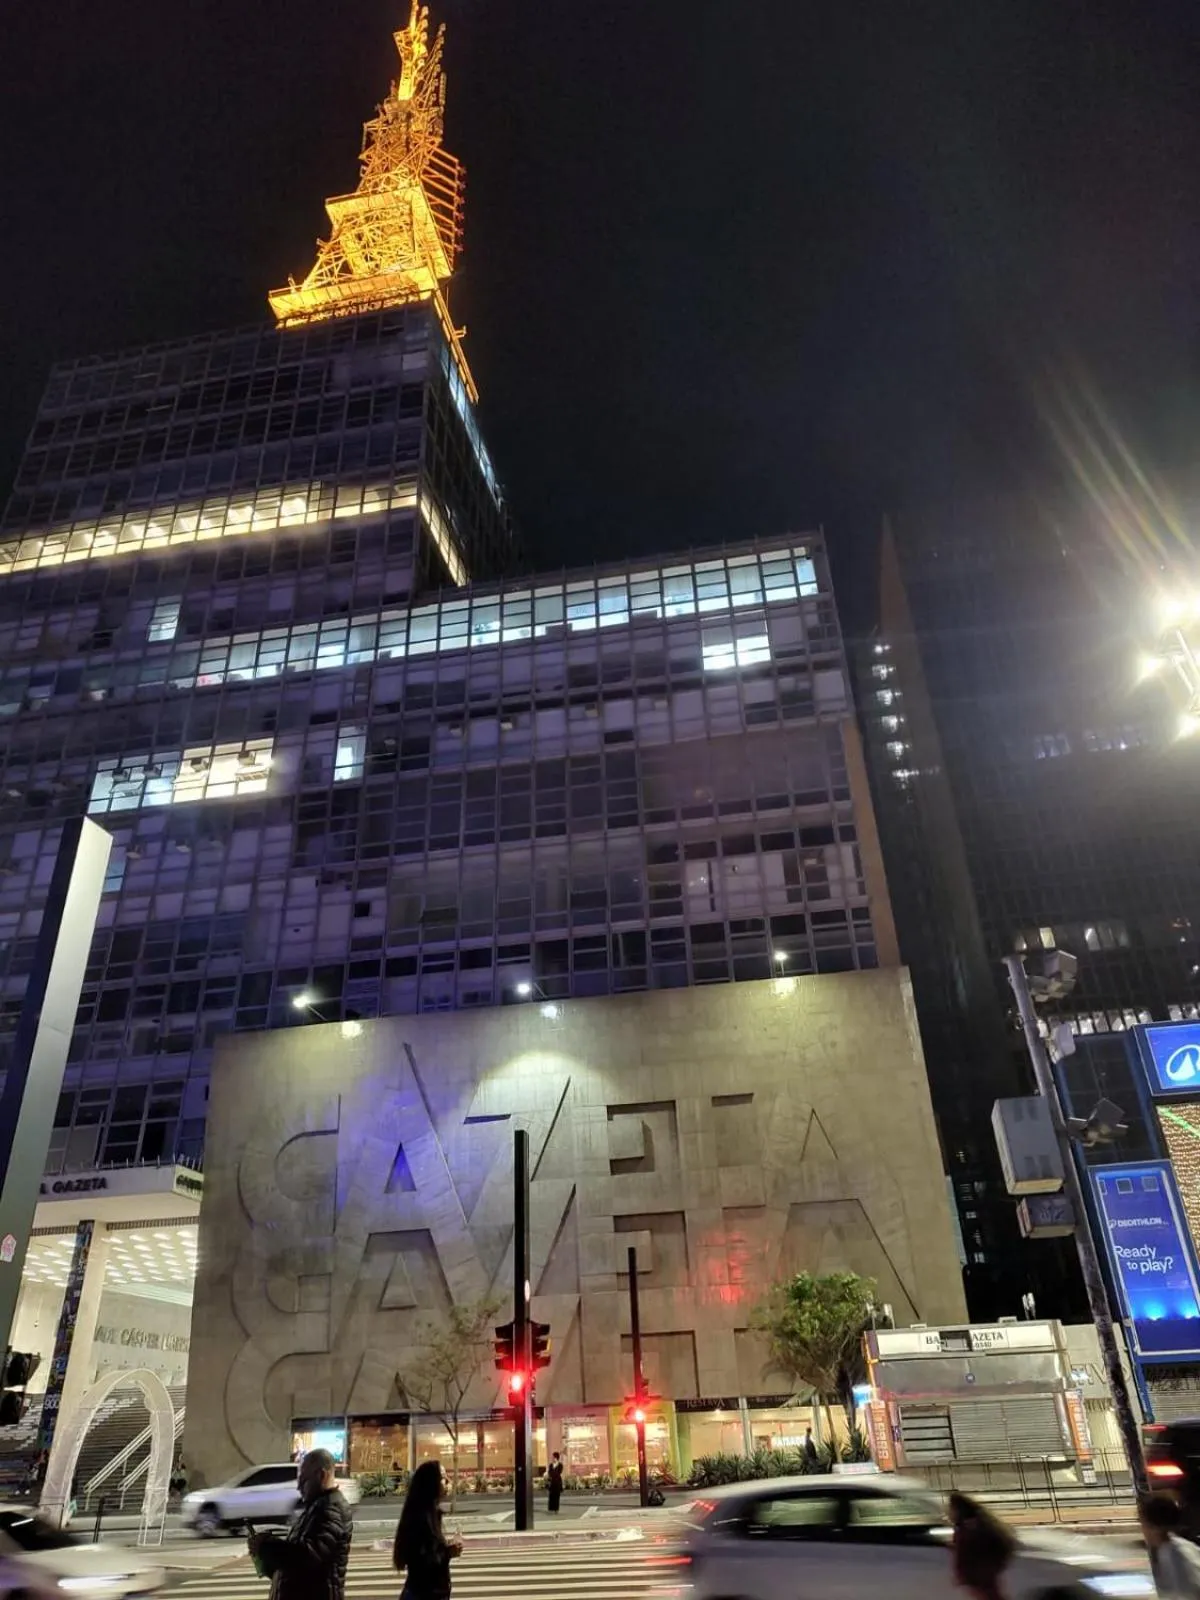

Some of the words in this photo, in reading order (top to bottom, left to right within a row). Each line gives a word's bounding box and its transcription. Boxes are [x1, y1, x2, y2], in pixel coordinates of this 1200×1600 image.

[52, 1177, 108, 1193] GAZETA
[1113, 1244, 1156, 1259] Ready
[1126, 1261, 1138, 1270] to
[1139, 1256, 1174, 1275] play?
